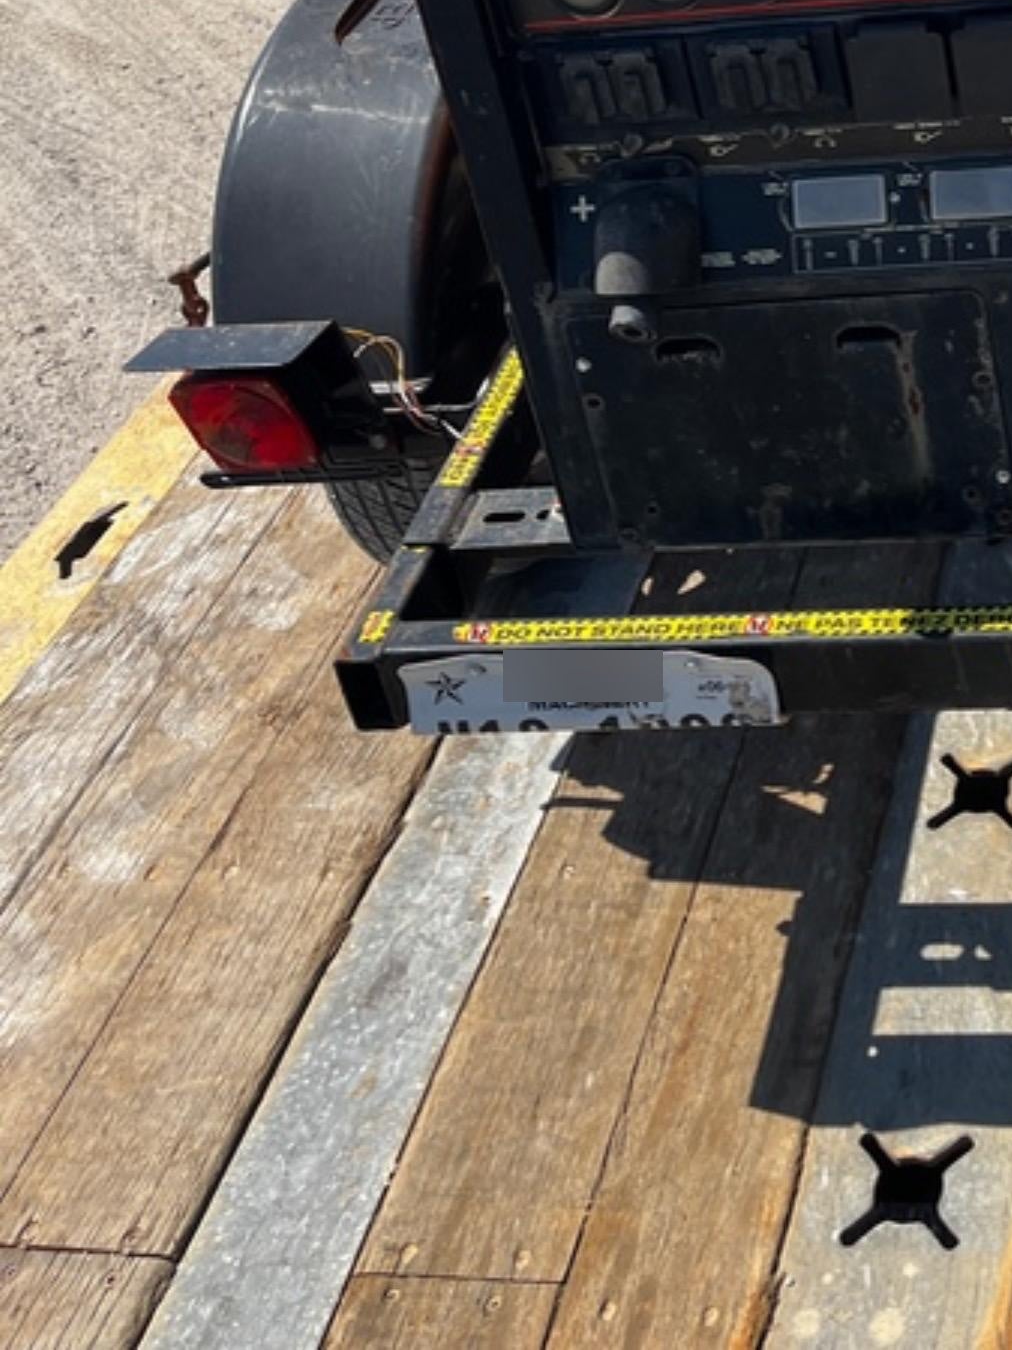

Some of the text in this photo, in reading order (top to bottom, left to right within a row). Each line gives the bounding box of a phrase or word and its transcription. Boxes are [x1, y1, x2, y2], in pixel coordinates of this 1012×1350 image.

[496, 619, 741, 640] DO NOT STAND HERE
